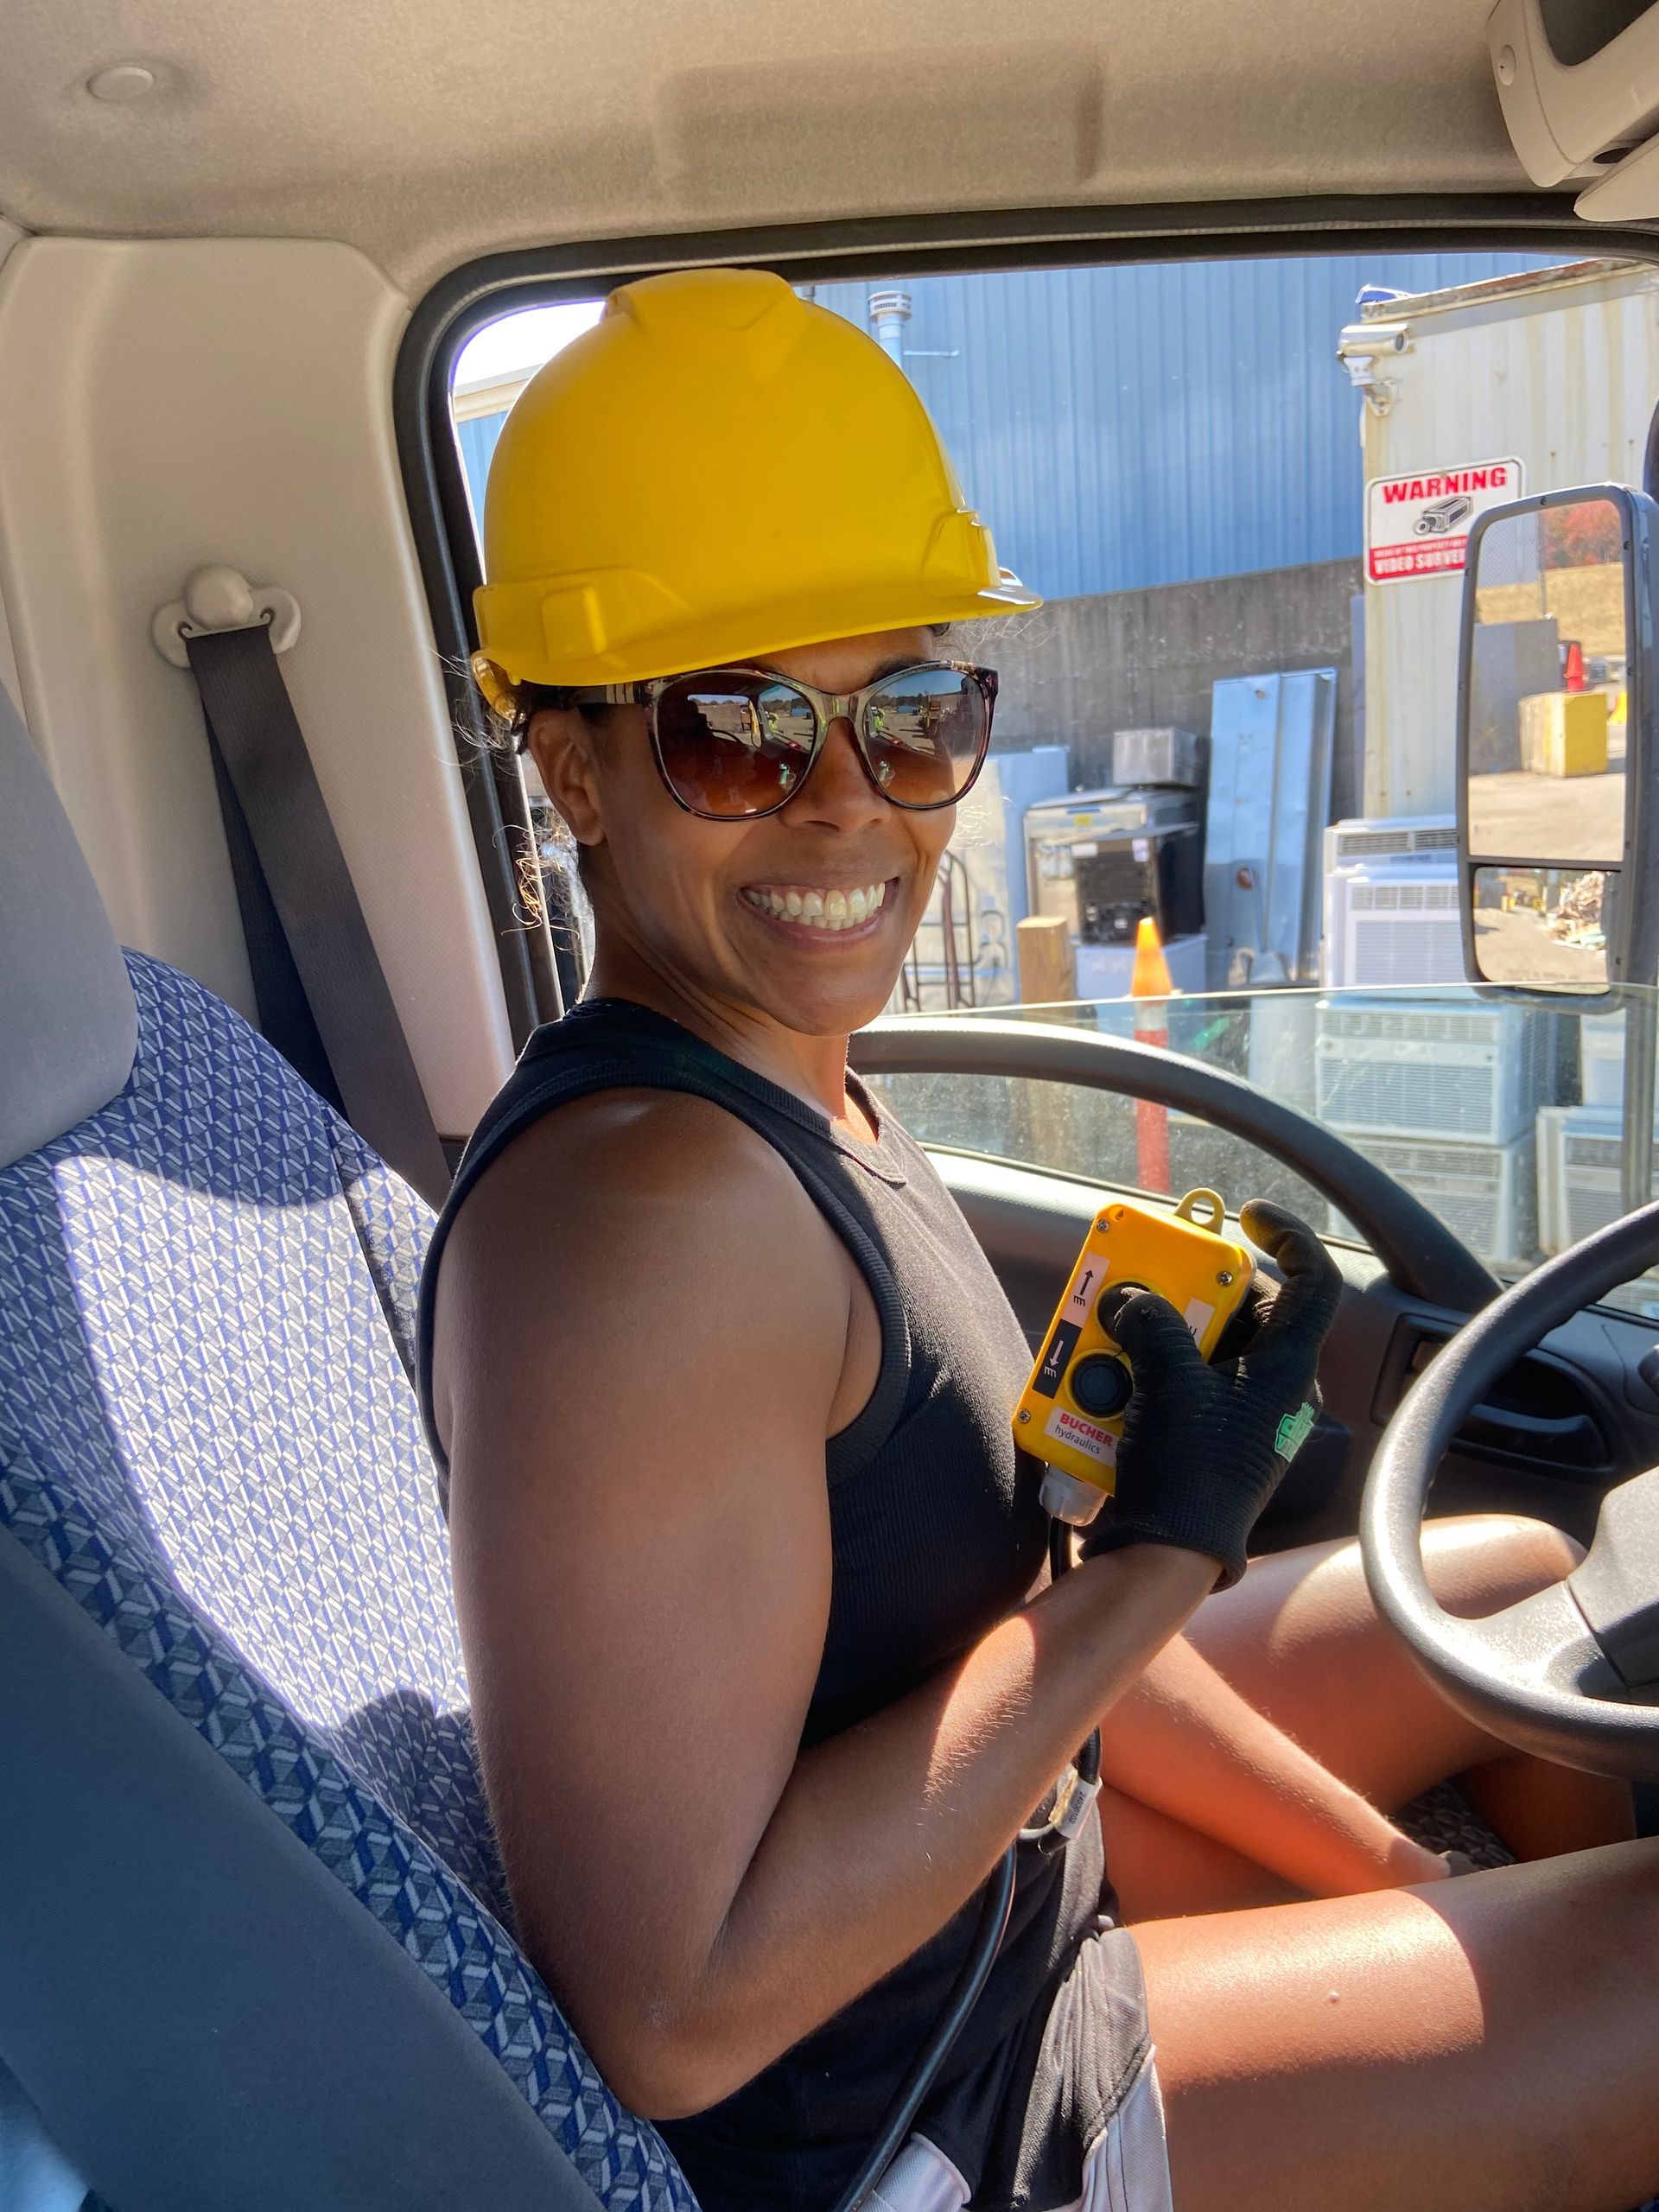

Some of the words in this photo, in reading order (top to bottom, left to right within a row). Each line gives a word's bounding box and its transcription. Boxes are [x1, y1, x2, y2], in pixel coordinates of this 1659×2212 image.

[1383, 467, 1507, 505] WARNING
[1054, 1424, 1102, 1454] hydraulics
[1059, 1413, 1113, 1447] BUCHER
